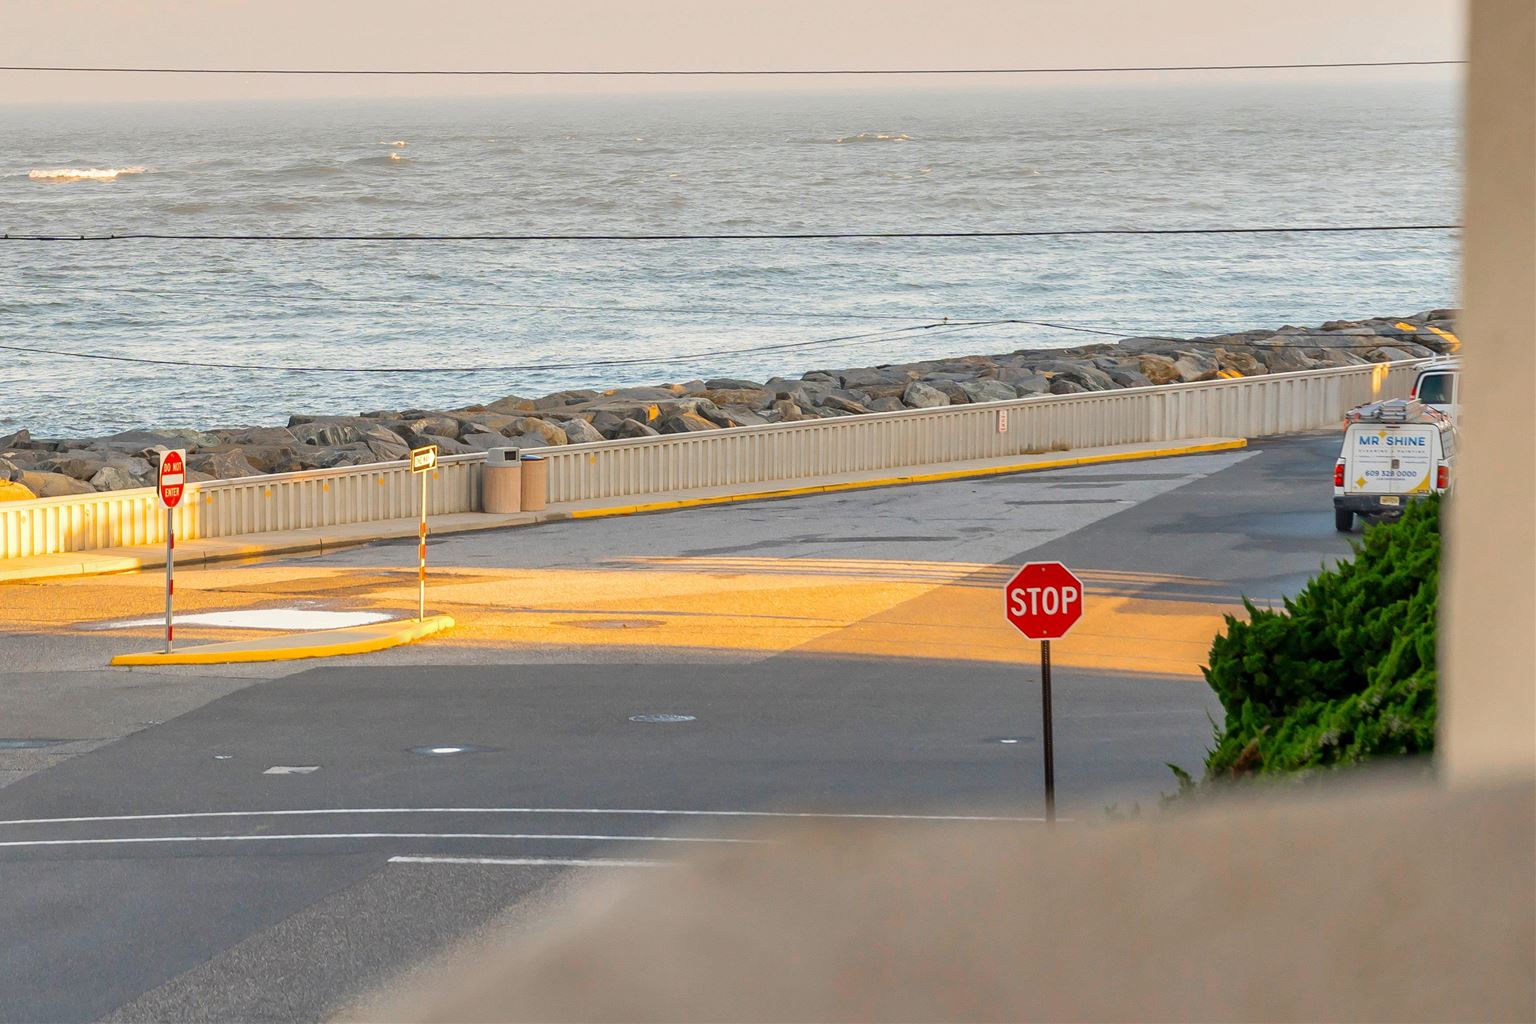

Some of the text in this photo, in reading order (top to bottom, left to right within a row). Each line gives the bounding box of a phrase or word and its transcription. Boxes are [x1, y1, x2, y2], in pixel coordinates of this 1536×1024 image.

[1359, 436, 1426, 446] MR SHINE
[163, 461, 182, 473] DO NOT
[165, 487, 180, 498] ENTER
[1010, 586, 1078, 617] STOP
